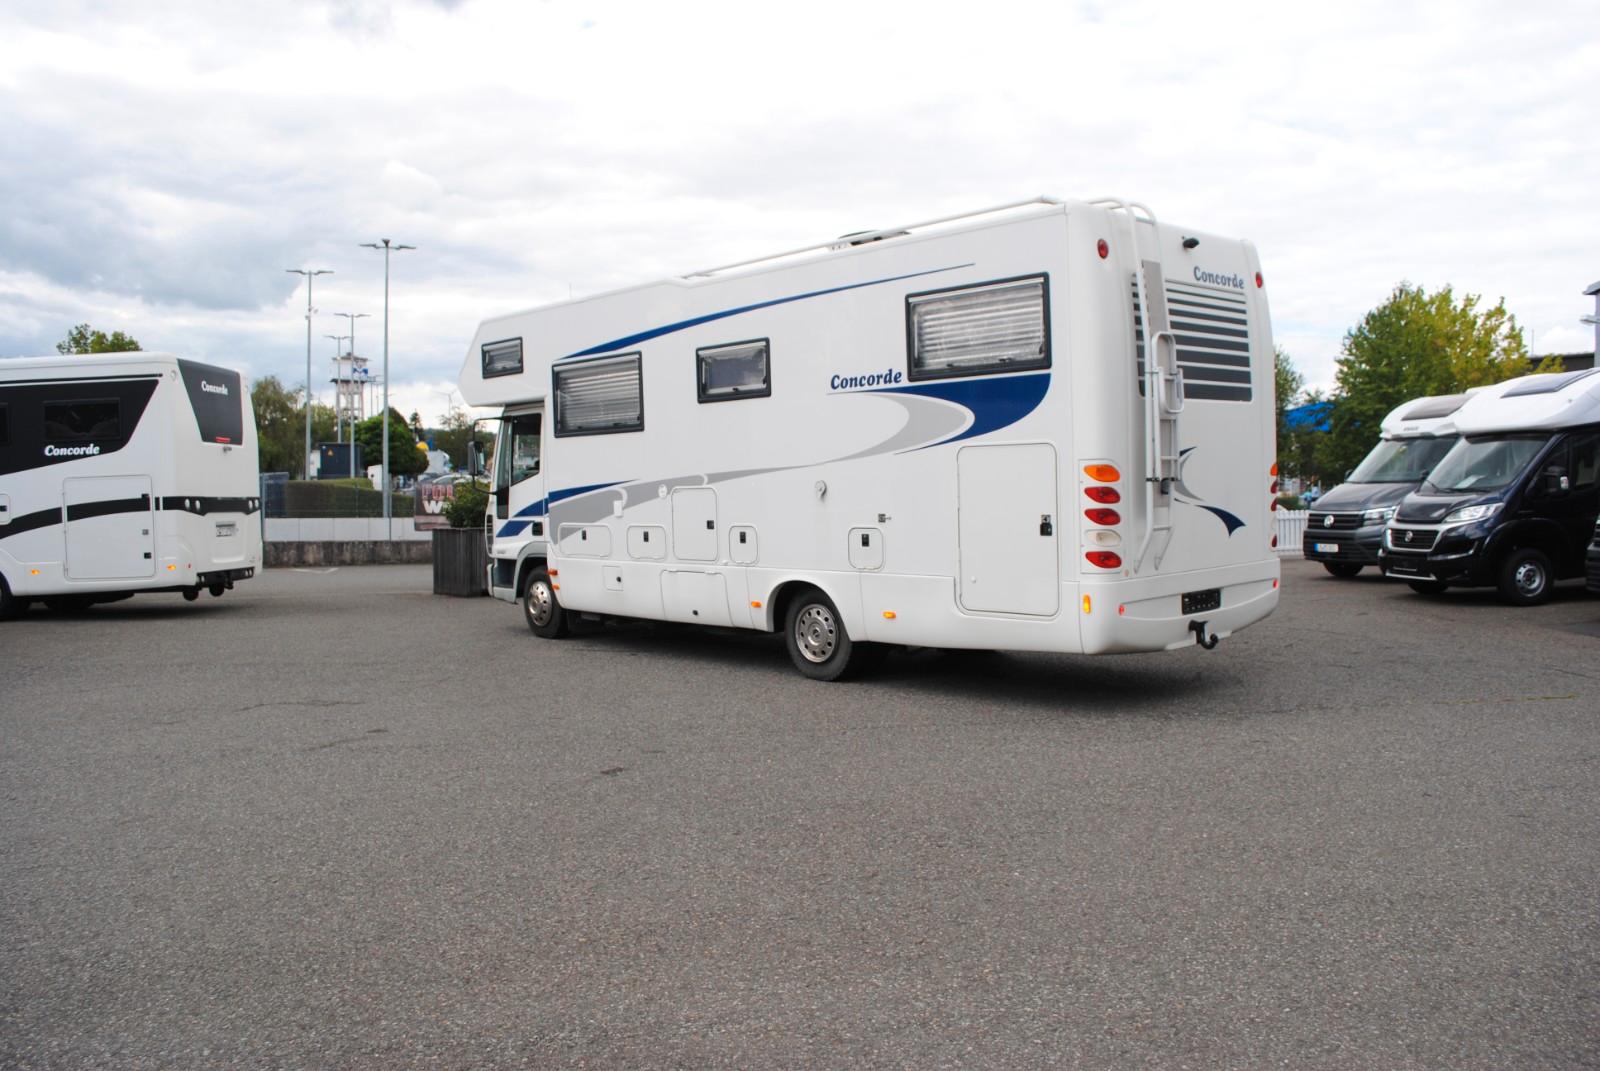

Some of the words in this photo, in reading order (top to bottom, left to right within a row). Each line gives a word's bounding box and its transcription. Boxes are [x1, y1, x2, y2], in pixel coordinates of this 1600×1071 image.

[1193, 265, 1245, 290] Concorde
[201, 380, 229, 396] Concorde
[830, 368, 903, 390] Concorde
[44, 443, 101, 457] Concorde
